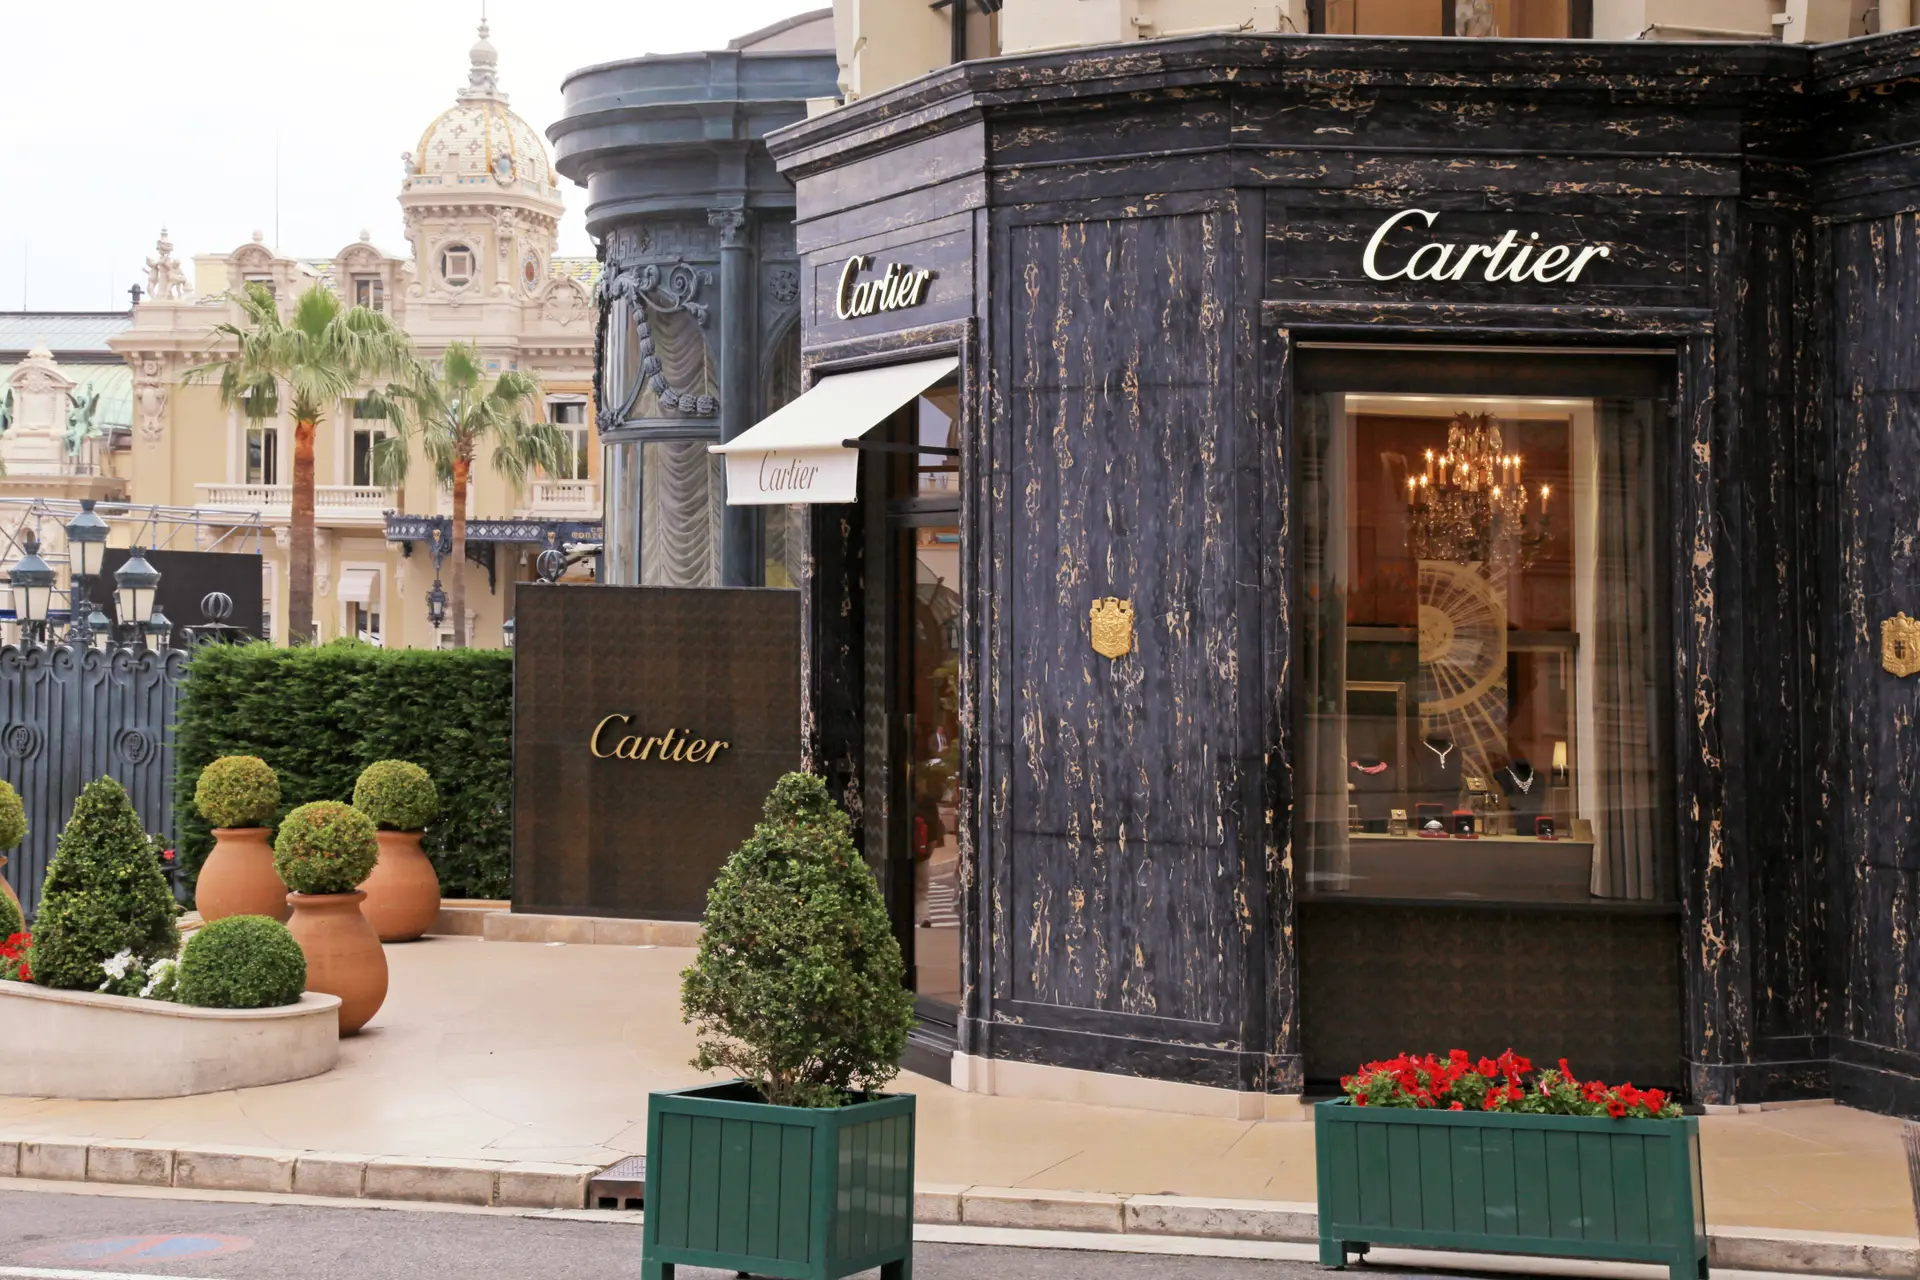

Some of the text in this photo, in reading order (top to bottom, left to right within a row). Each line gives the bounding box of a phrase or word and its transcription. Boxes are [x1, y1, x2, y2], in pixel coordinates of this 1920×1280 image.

[1363, 208, 1609, 283] Cartier
[836, 255, 929, 320] Cartier
[759, 450, 818, 492] Cartier
[590, 713, 729, 764] Cartier
